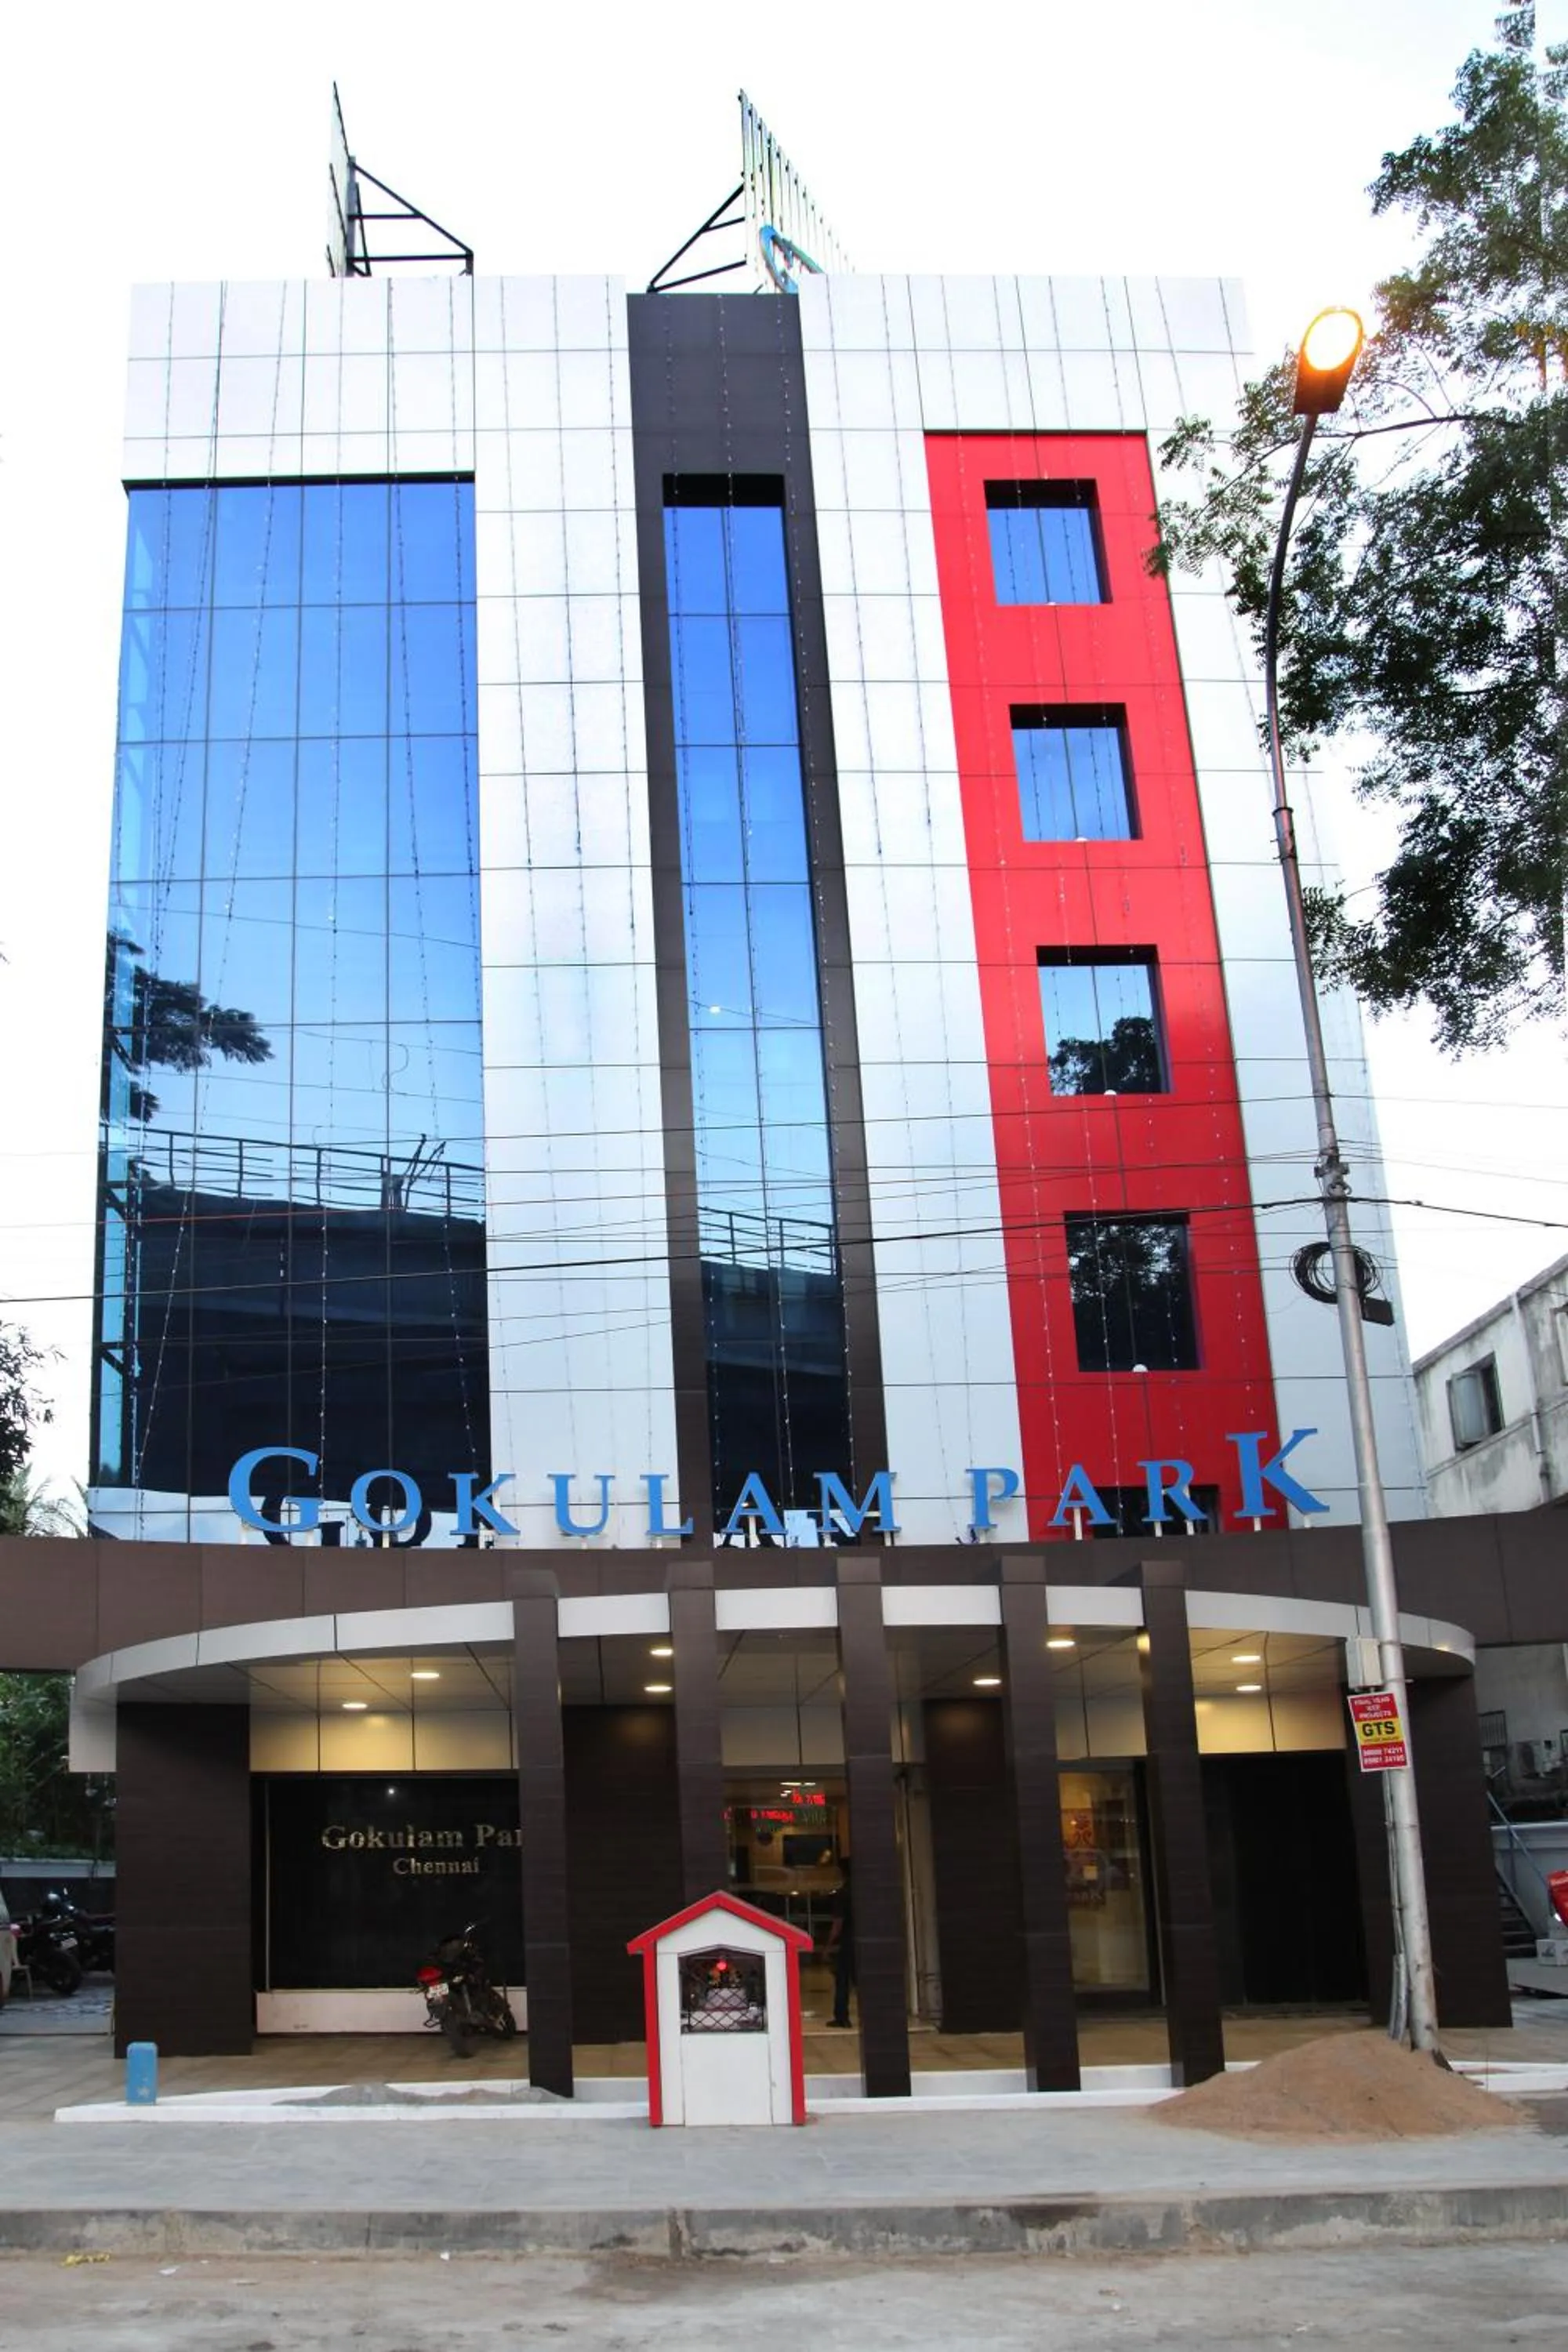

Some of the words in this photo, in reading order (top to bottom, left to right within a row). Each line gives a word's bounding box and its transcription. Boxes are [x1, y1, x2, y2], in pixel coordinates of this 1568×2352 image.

[228, 1446, 896, 1535] GOKULAM
[966, 1428, 1330, 1530] PARK
[1362, 1721, 1395, 1737] GTS
[321, 1824, 463, 1849] Gokulam
[392, 1857, 479, 1875] Chennai
